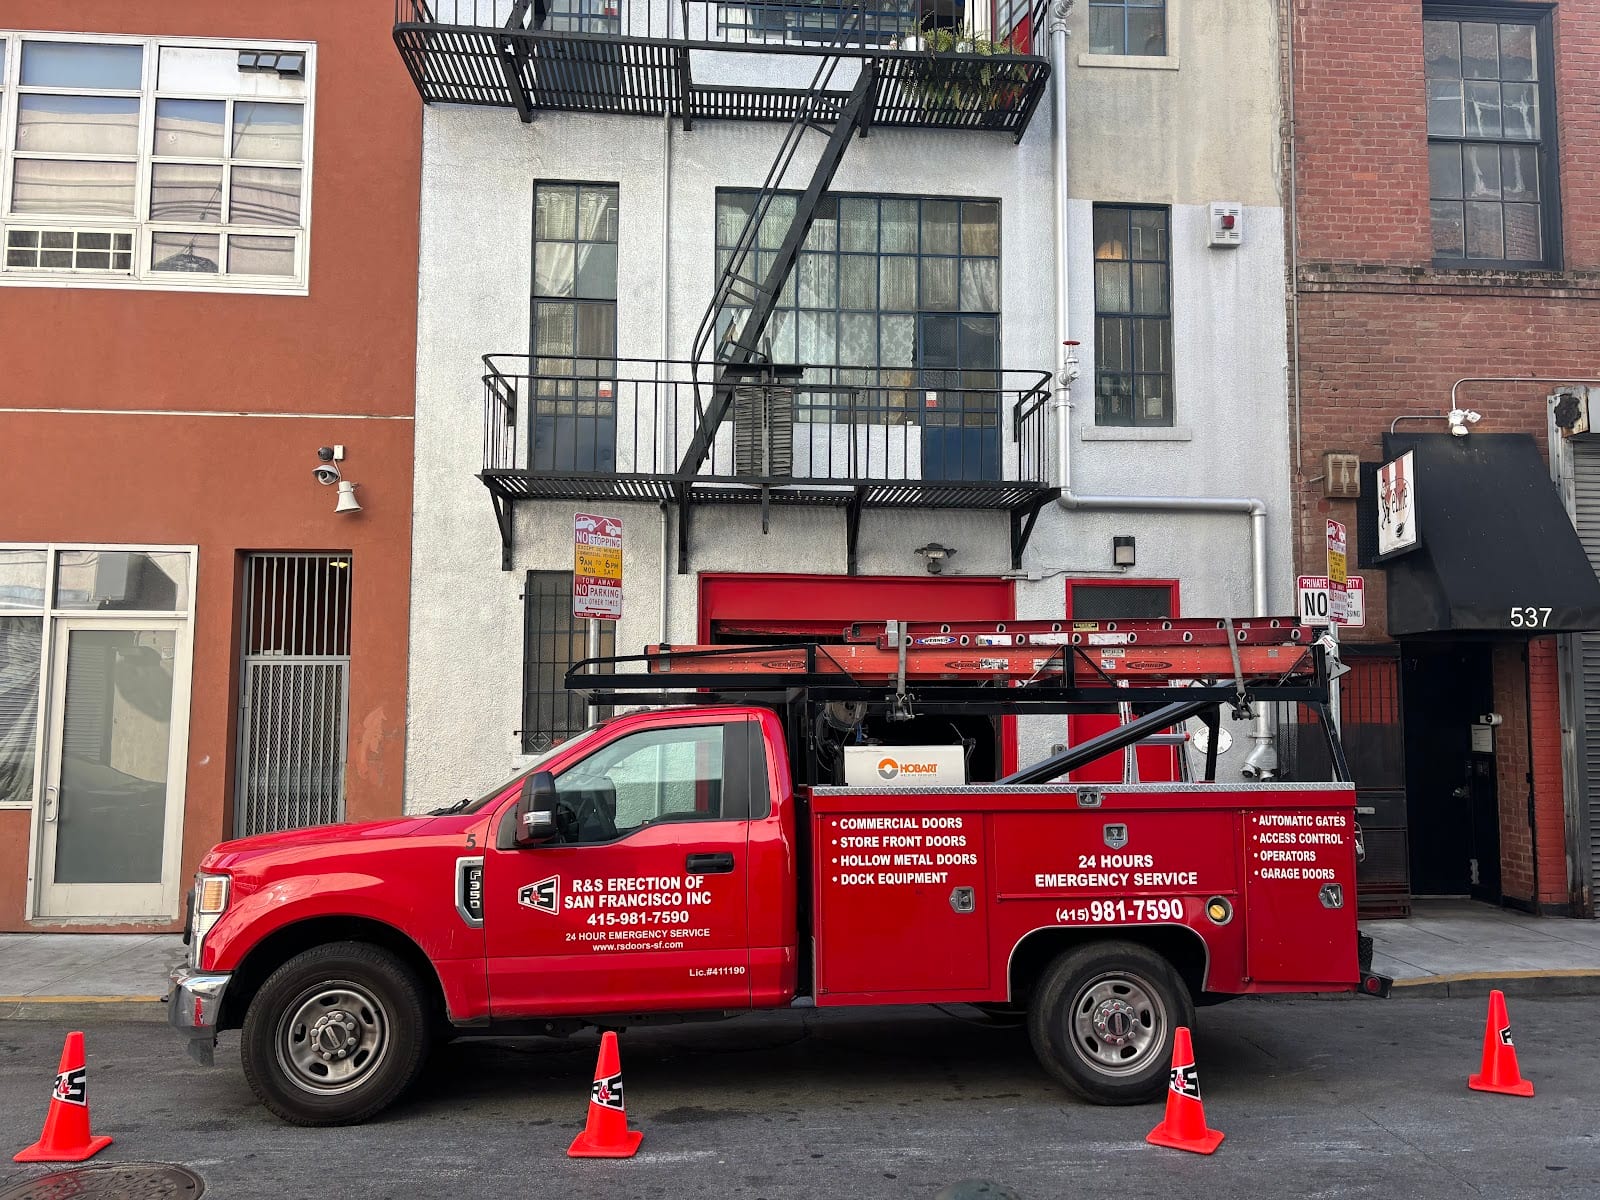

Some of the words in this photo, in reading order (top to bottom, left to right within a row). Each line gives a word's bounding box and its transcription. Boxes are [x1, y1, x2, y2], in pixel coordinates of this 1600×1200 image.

[576, 531, 588, 543] NO
[590, 535, 620, 548] STOPPING
[579, 556, 592, 566] 9AM
[605, 560, 618, 569] 6PM
[583, 566, 596, 574] MON
[597, 579, 615, 587] AWAY
[1302, 578, 1327, 588] PRIVATE
[576, 583, 588, 596] NO
[590, 587, 619, 599] PARKING
[1304, 591, 1328, 617] NO
[1510, 607, 1552, 628] 537
[900, 764, 937, 773] HOBART
[840, 818, 919, 830] COMMERCIAL
[922, 817, 963, 829] DOORS
[1259, 815, 1313, 826] AUTOMATIC
[1315, 816, 1346, 827] GATES
[466, 834, 476, 850] 5
[840, 836, 879, 848] STORE
[882, 836, 922, 847] FRONT
[925, 835, 967, 847] DOORS
[1260, 833, 1297, 844] ACCESS
[1299, 833, 1344, 844] CONTROL
[840, 854, 891, 866] HOLLOW
[894, 854, 933, 866] METAL
[936, 853, 978, 865] DOORS
[1078, 855, 1097, 869] 24
[1100, 855, 1154, 868] HOURS
[1260, 850, 1316, 861] OPERATORS
[840, 873, 875, 885] DOCK
[878, 872, 948, 885] EQUIPMENT
[1035, 873, 1129, 887] EMERGENCY
[1133, 872, 1198, 886] SERVICE
[1260, 868, 1300, 879] GARAGE
[1302, 869, 1335, 879] DOORS
[470, 869, 481, 909] F350
[572, 878, 604, 892] R&S
[607, 876, 681, 892] ERECTION
[685, 876, 704, 889] OF
[520, 879, 556, 911] R&S
[564, 895, 594, 909] SAN
[598, 893, 682, 908] FRANCISCO
[686, 891, 712, 905] INC
[1055, 908, 1090, 922] (415)
[1090, 899, 1184, 922] 981-7590
[587, 910, 690, 926] 415-981-7590
[565, 932, 577, 941] 24
[578, 931, 606, 941] HOUR
[608, 930, 668, 940] EMERGENCY
[669, 928, 711, 938] SERVICE
[592, 941, 684, 951] www.rsdoors-sf.com
[689, 966, 745, 977] Lic.#411190
